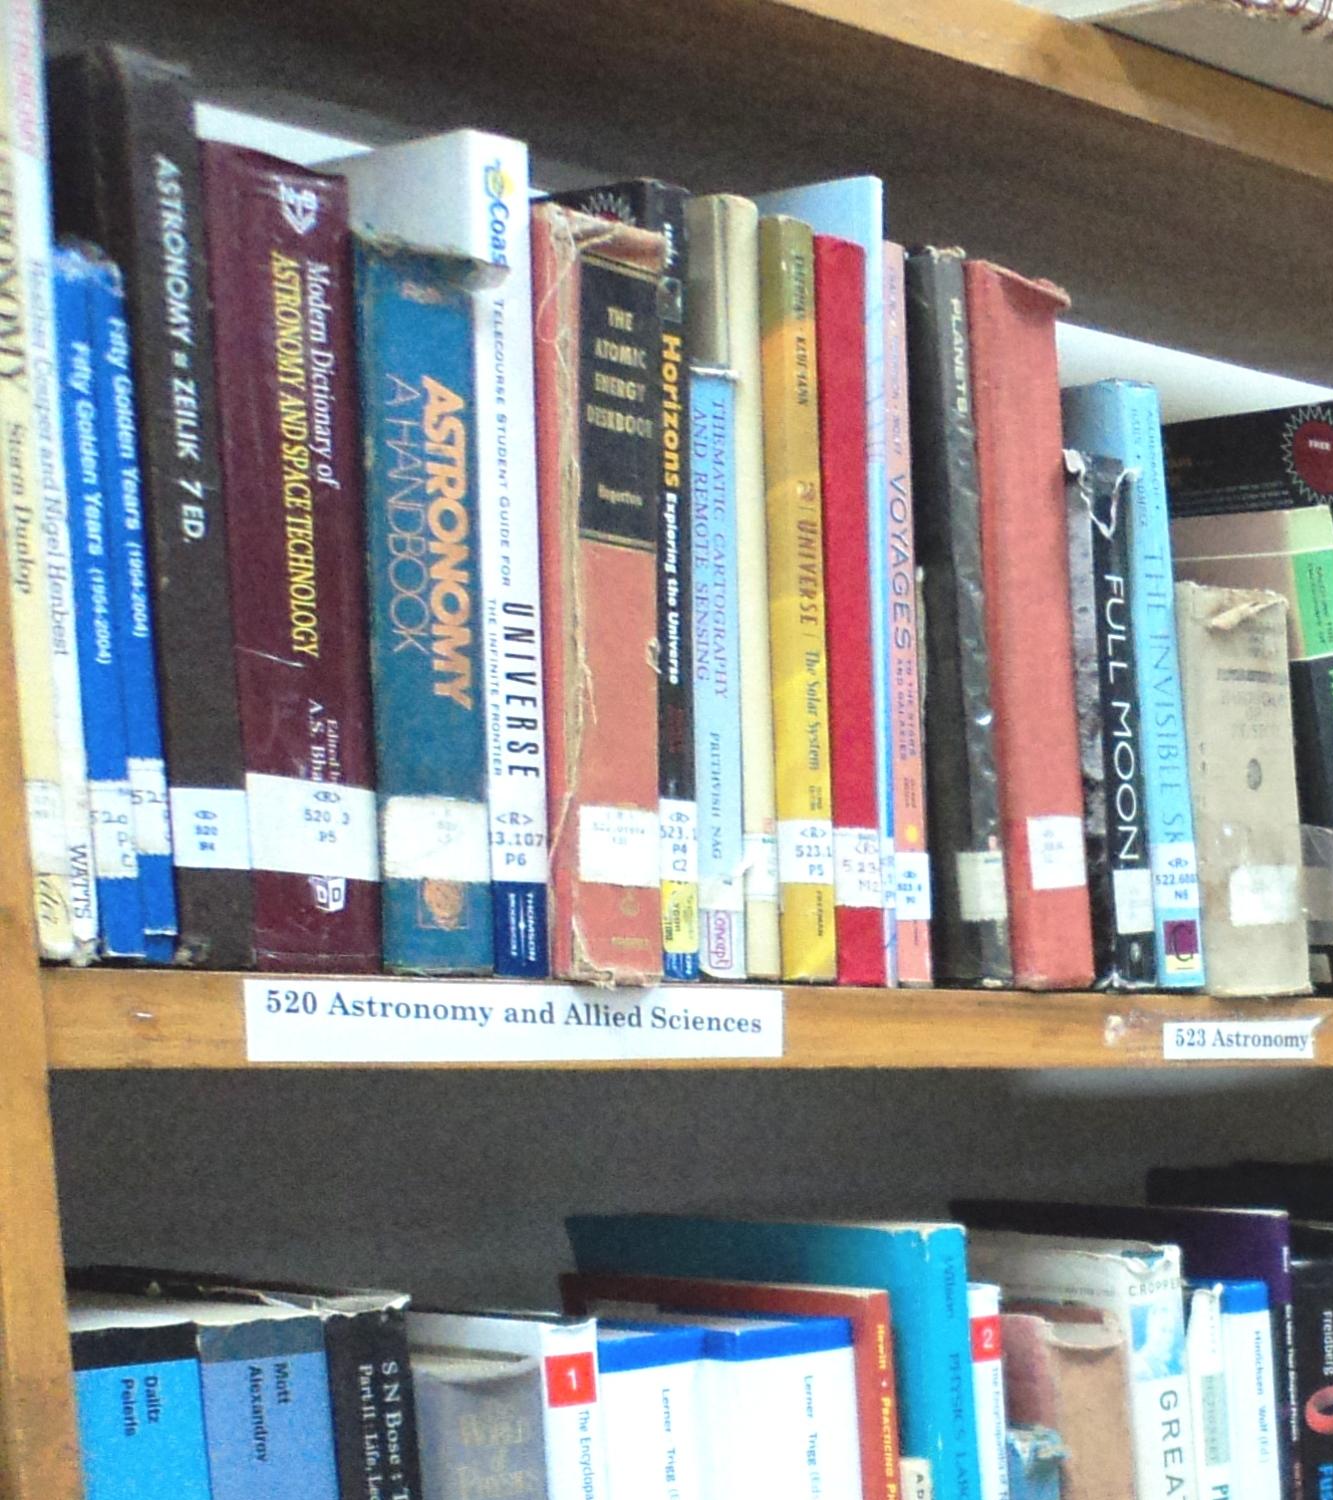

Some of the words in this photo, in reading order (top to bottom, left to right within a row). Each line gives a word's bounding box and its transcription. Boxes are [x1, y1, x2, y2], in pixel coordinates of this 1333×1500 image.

[154, 152, 195, 347] ASTRONOMY
[271, 250, 306, 391] ASTRONOMY
[306, 258, 334, 343] Modern
[492, 299, 507, 404] TELECOURSE
[171, 376, 201, 462] ZEILIK
[278, 397, 309, 441] AND
[307, 348, 337, 456] Dictionary
[385, 373, 421, 406] A
[660, 332, 683, 488] Horizons
[495, 412, 510, 491] STUDENT
[692, 407, 709, 460] AND
[710, 399, 728, 524] THEMATIC
[1307, 438, 1332, 451] FREE
[119, 467, 142, 531] Years
[281, 441, 314, 511] SPACE
[314, 464, 341, 490] of
[83, 491, 105, 557] Years
[181, 503, 206, 545] ED.
[384, 416, 432, 656] HANDBOOK
[420, 373, 474, 712] ASTRONOMY
[499, 496, 512, 550] GUIDE
[661, 493, 681, 582] Exploring
[693, 466, 709, 570] REMOTE
[285, 513, 320, 660] TECHNOLOGY
[500, 555, 512, 587] FOR
[796, 519, 819, 626] UNIVERSE
[887, 472, 913, 650] VOYAGES
[1143, 554, 1169, 622] THE
[487, 599, 499, 626] THE
[666, 585, 681, 609] the
[695, 580, 710, 682] SENSING
[711, 531, 730, 699] CARTOGRAPHY
[1101, 573, 1129, 685] FULL
[488, 631, 501, 696] INFINITE
[667, 613, 681, 685] Universe
[804, 650, 821, 677] The
[502, 601, 541, 779] UNIVERSE
[804, 680, 821, 718] Solar
[1147, 634, 1180, 795] INVISIBLE
[490, 703, 504, 778] FRONTIER
[805, 719, 822, 773] System
[1109, 699, 1141, 864] MOON
[68, 844, 93, 920] WATTS
[505, 852, 527, 867] P6
[808, 863, 826, 878] P5
[266, 990, 318, 1015] 520
[328, 991, 494, 1028] Astronomy
[503, 999, 556, 1026] and
[563, 998, 642, 1029] Allied
[651, 1005, 762, 1033] Sciences
[1175, 1028, 1206, 1048] 523
[1211, 1027, 1309, 1051] Astronomy
[981, 1327, 994, 1350] 2
[144, 1375, 162, 1424] Dalitz
[272, 1361, 290, 1405] Mott
[566, 1368, 578, 1390] 1
[661, 1386, 673, 1435] Lerner
[248, 1364, 270, 1463] Alexandrov
[384, 1411, 403, 1466] Bose
[577, 1410, 590, 1434] The
